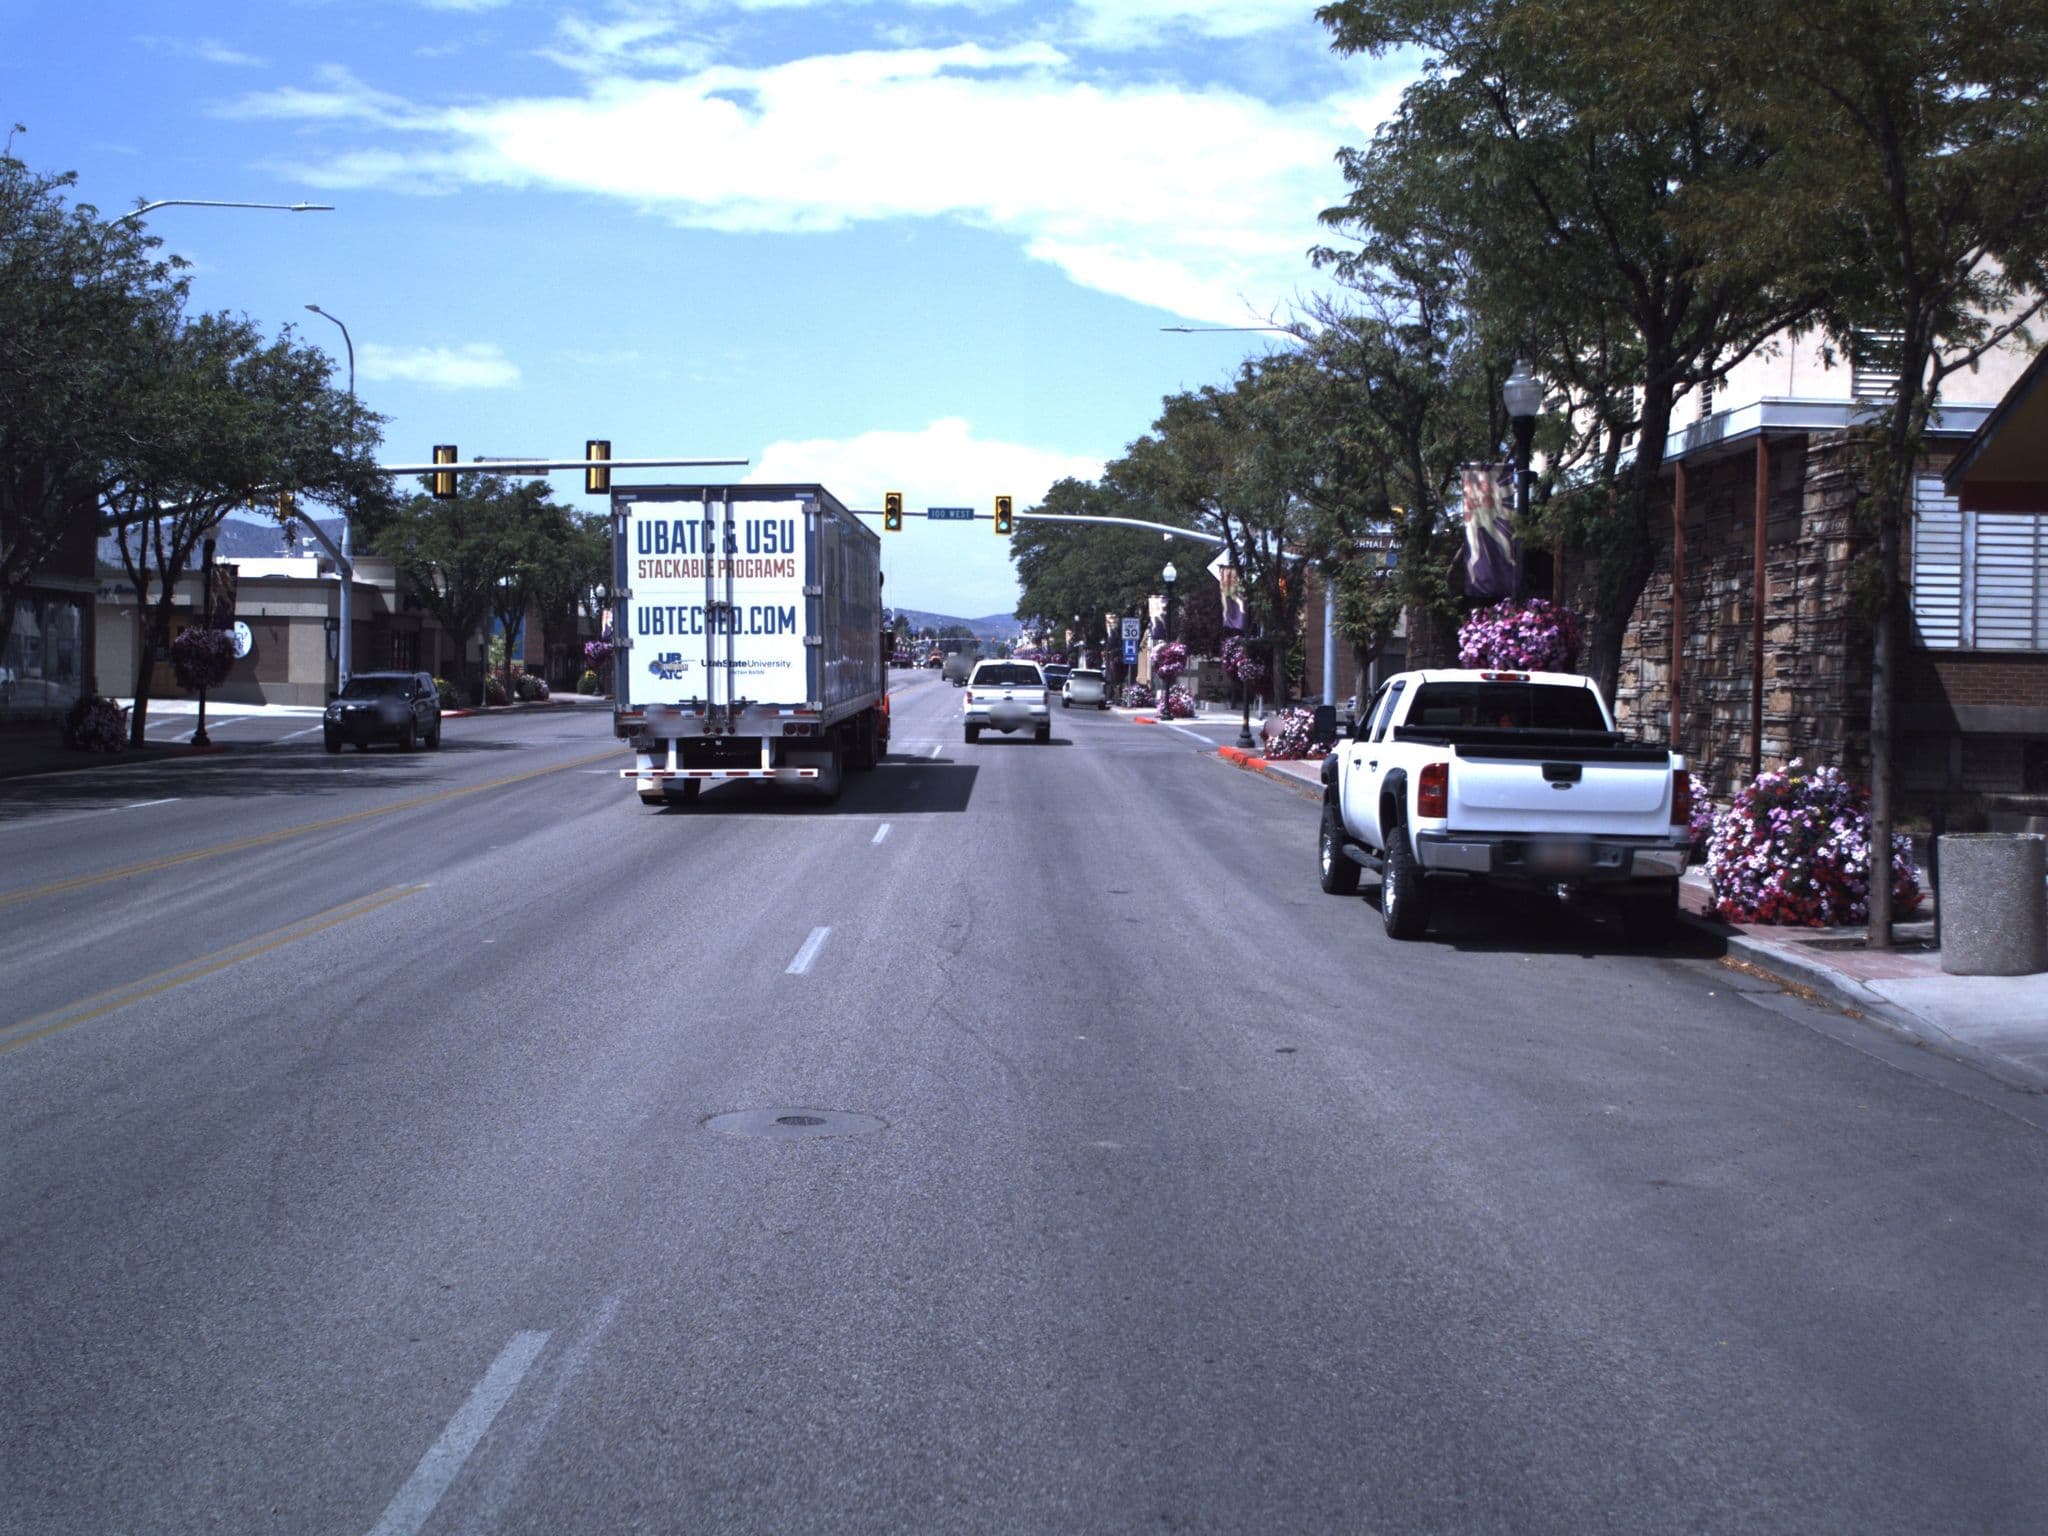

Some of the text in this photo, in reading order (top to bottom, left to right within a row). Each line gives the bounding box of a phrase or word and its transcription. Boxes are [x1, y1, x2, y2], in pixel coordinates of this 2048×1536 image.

[931, 510, 970, 518] 100 WEST
[637, 519, 795, 554] UBATC & USU
[638, 558, 795, 579] STACKABLE PROGRAMS
[1124, 629, 1138, 637] 30
[1125, 640, 1136, 654] H
[659, 670, 682, 680] ATC
